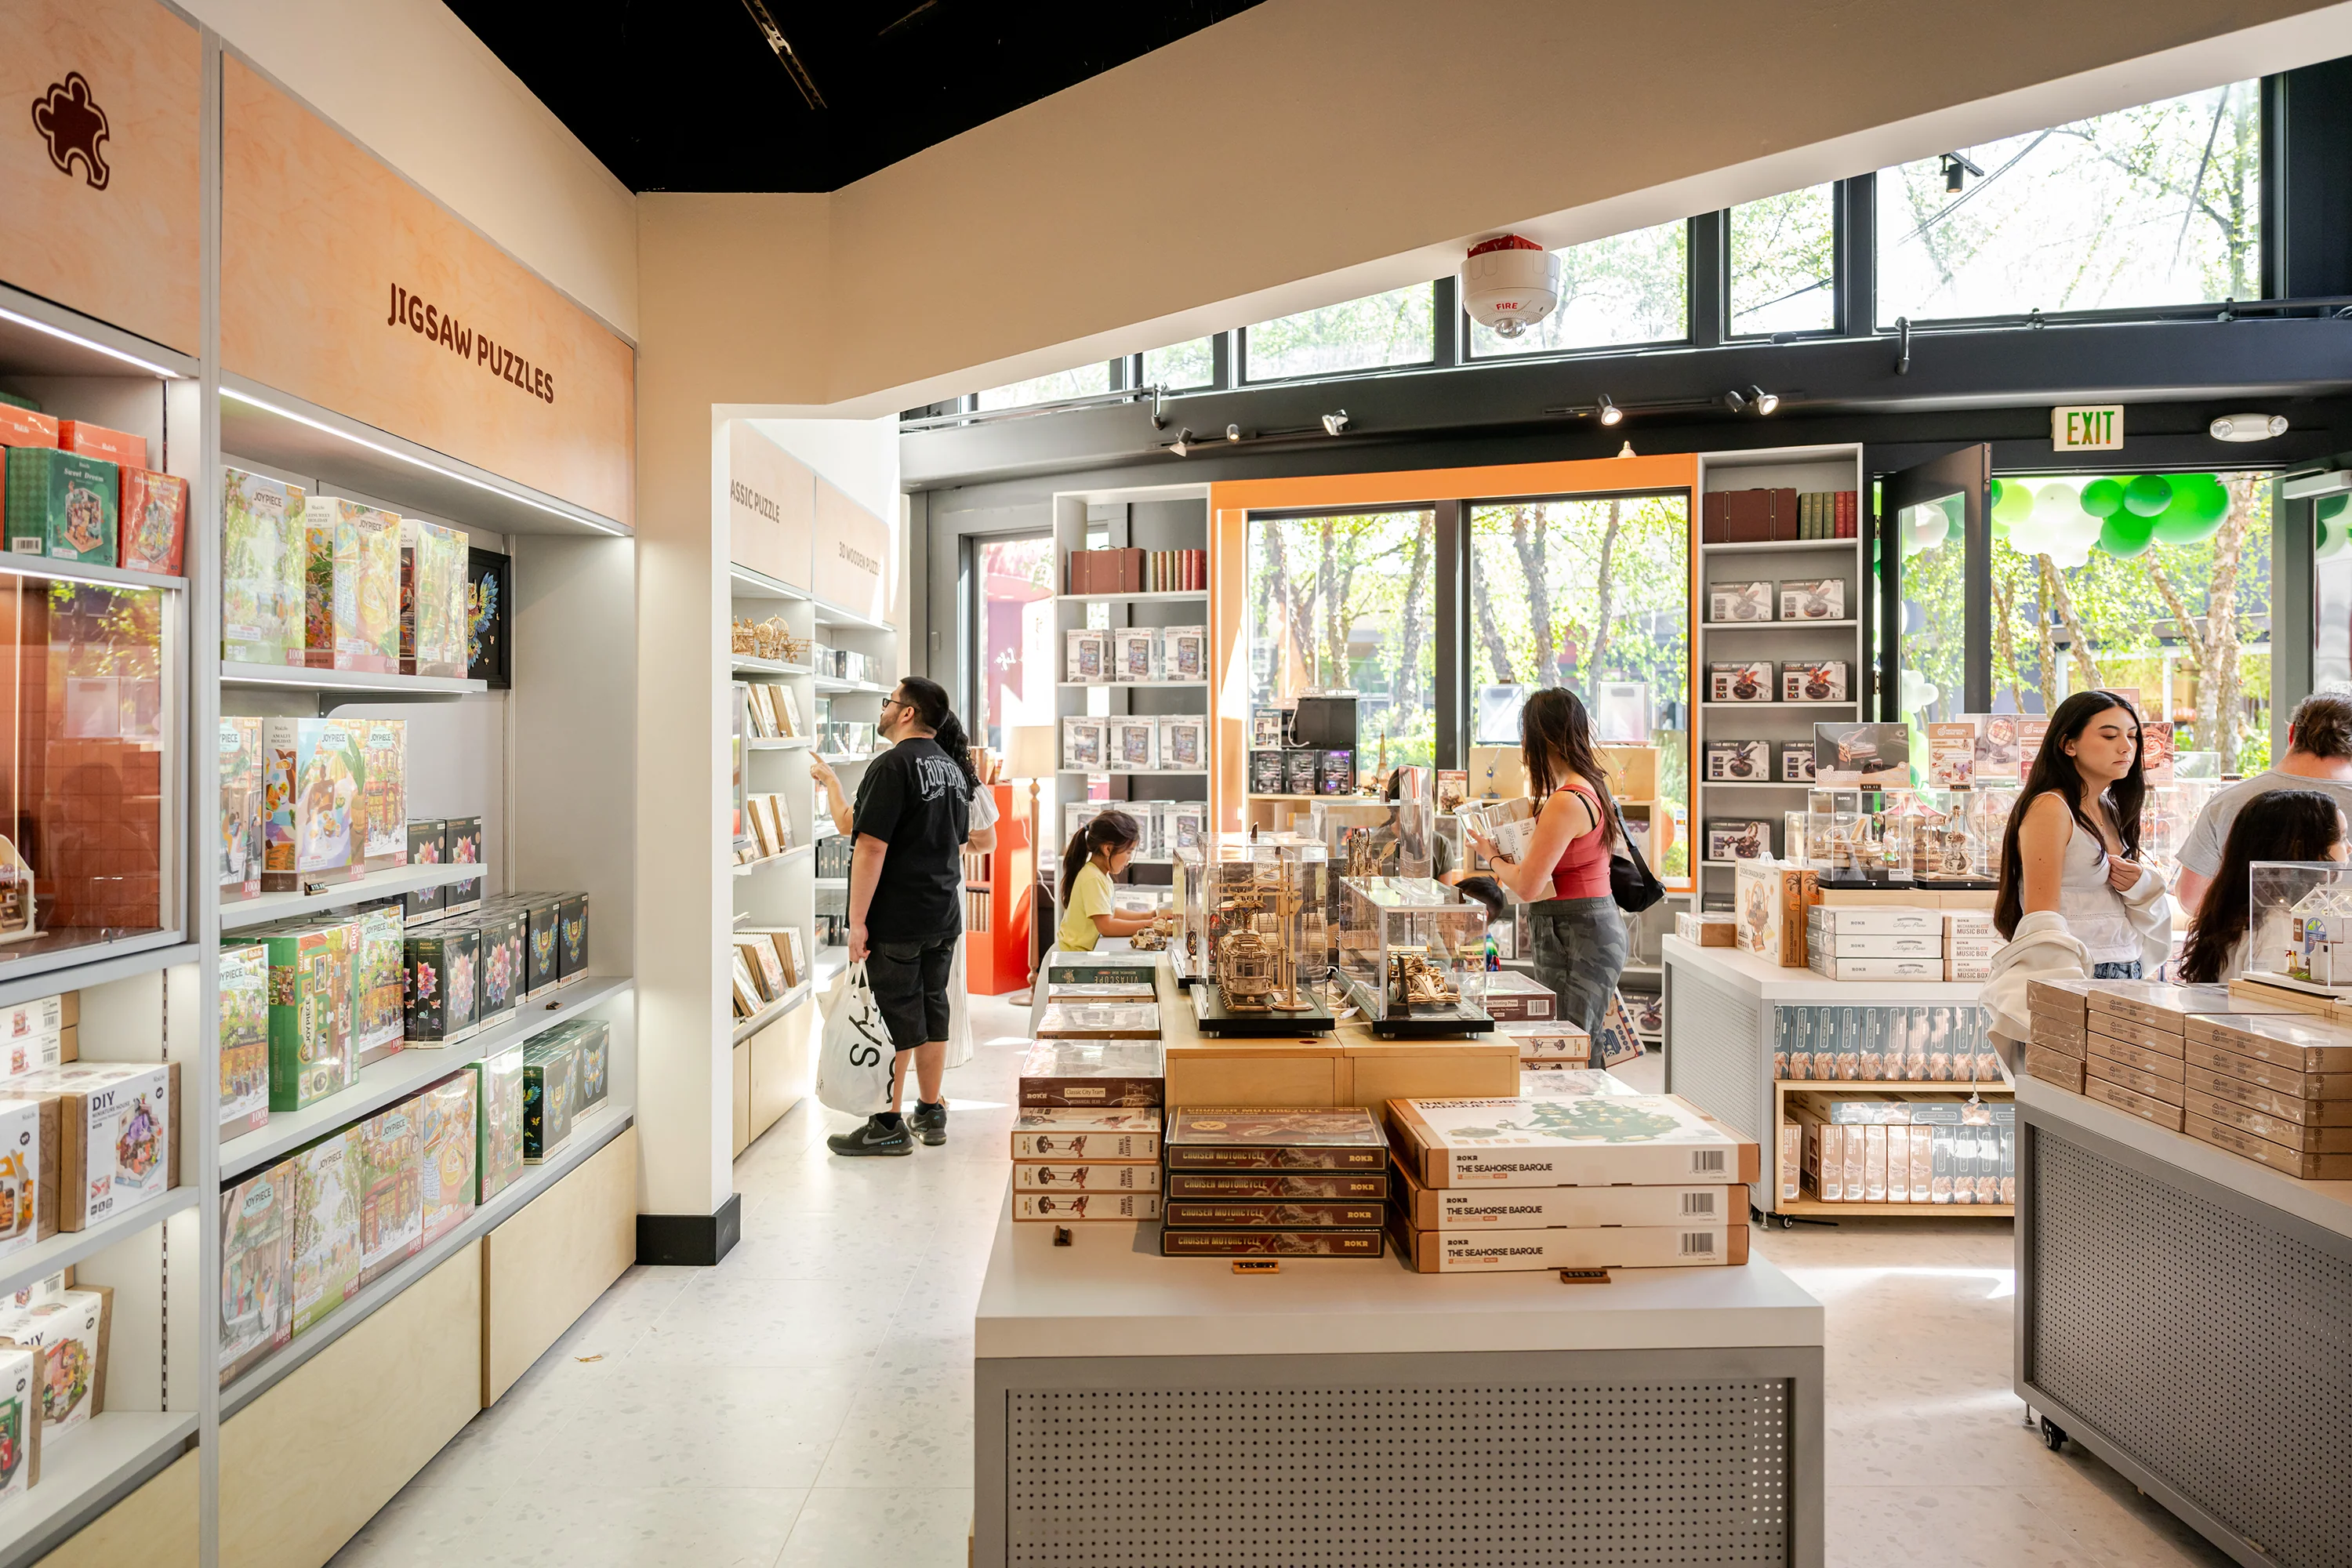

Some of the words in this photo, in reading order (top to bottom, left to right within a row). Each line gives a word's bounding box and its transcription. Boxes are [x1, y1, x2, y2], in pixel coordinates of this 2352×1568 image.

[1496, 302, 1519, 310] FIRE
[388, 282, 472, 360] JIGSAW
[478, 334, 554, 404] PUZZLES
[2067, 410, 2115, 446] EXIT
[64, 468, 82, 479] Sweet
[84, 472, 104, 482] Dream
[253, 492, 282, 508] JOYPIECE
[754, 492, 780, 524] PUZZLE
[358, 518, 383, 532] JOYPIECE
[839, 541, 846, 558] 3D
[846, 546, 866, 570] WOODEN
[322, 734, 345, 742] JOYPIECE
[395, 851, 407, 861] 1000
[350, 865, 365, 874] 1000
[244, 881, 260, 892] 1000
[365, 923, 387, 935] JOYPIECE
[93, 1091, 115, 1111] DIY
[252, 1108, 267, 1123] 1000
[383, 1119, 405, 1136] JOYPIECE
[318, 1150, 343, 1170] JOYPIECE
[1182, 1151, 1214, 1160] CRUISER
[1216, 1151, 1265, 1160] MOTORCYCLE
[1474, 1163, 1518, 1172] SEAHORSE
[1519, 1163, 1552, 1171] BARQUE
[1185, 1180, 1215, 1189] CRUISER
[1218, 1180, 1267, 1189] MOTORCYCLE
[245, 1187, 270, 1210] JOYPIECE
[1181, 1207, 1213, 1216] CRUISER
[1214, 1207, 1264, 1217] MOTORCYCLE
[1211, 1236, 1261, 1245] MOTORCYCLE
[1510, 1247, 1543, 1255] BARQUE
[275, 1323, 291, 1342] 1000
